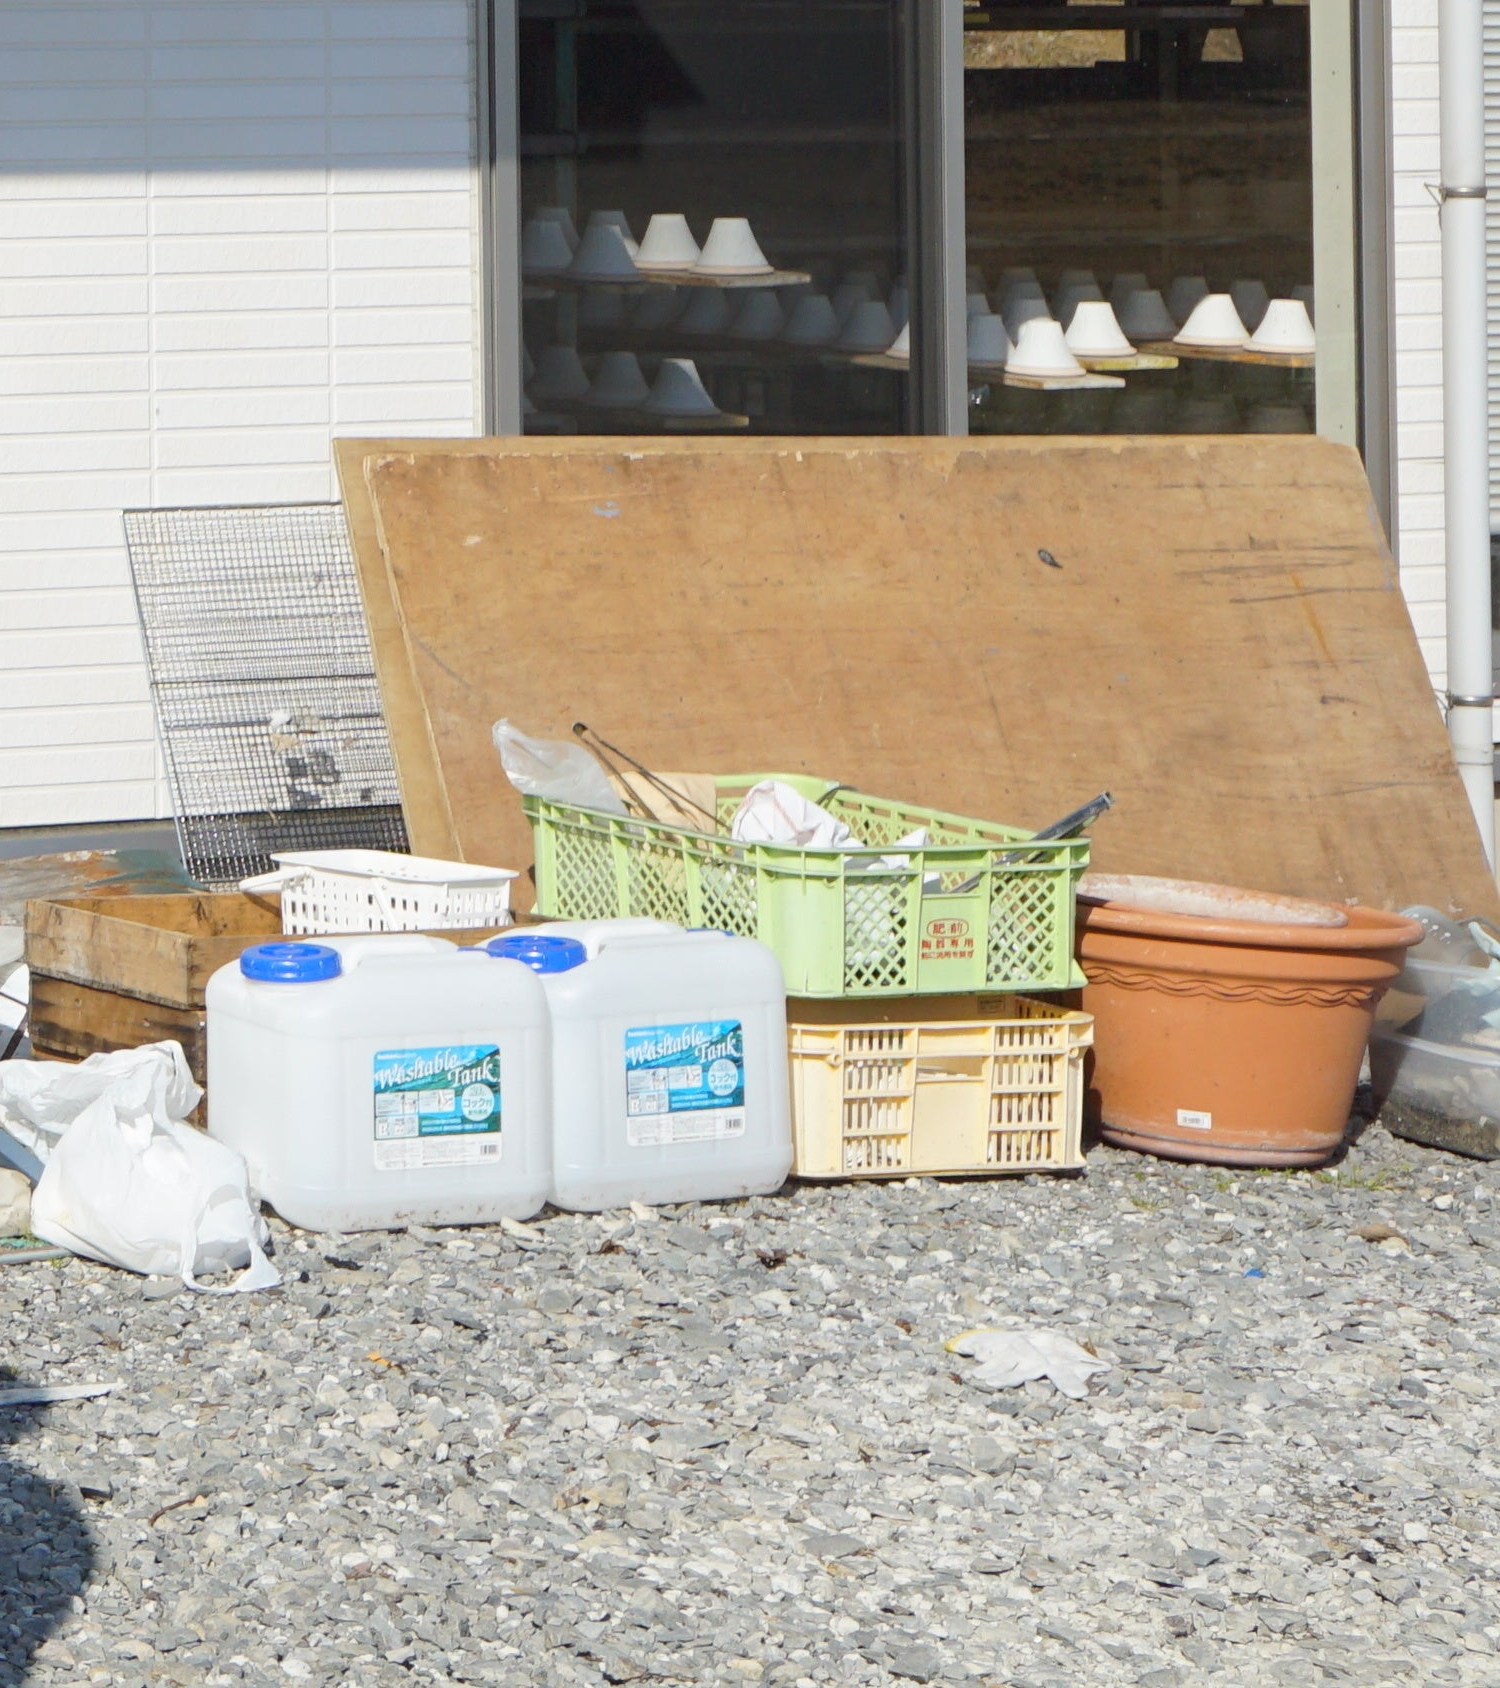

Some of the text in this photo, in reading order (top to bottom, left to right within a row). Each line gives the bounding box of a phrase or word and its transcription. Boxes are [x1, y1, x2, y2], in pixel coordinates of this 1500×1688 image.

[626, 1023, 704, 1066] Washable
[694, 1031, 743, 1063] Tank
[375, 1048, 459, 1089] Washable
[447, 1056, 500, 1088] Tank
